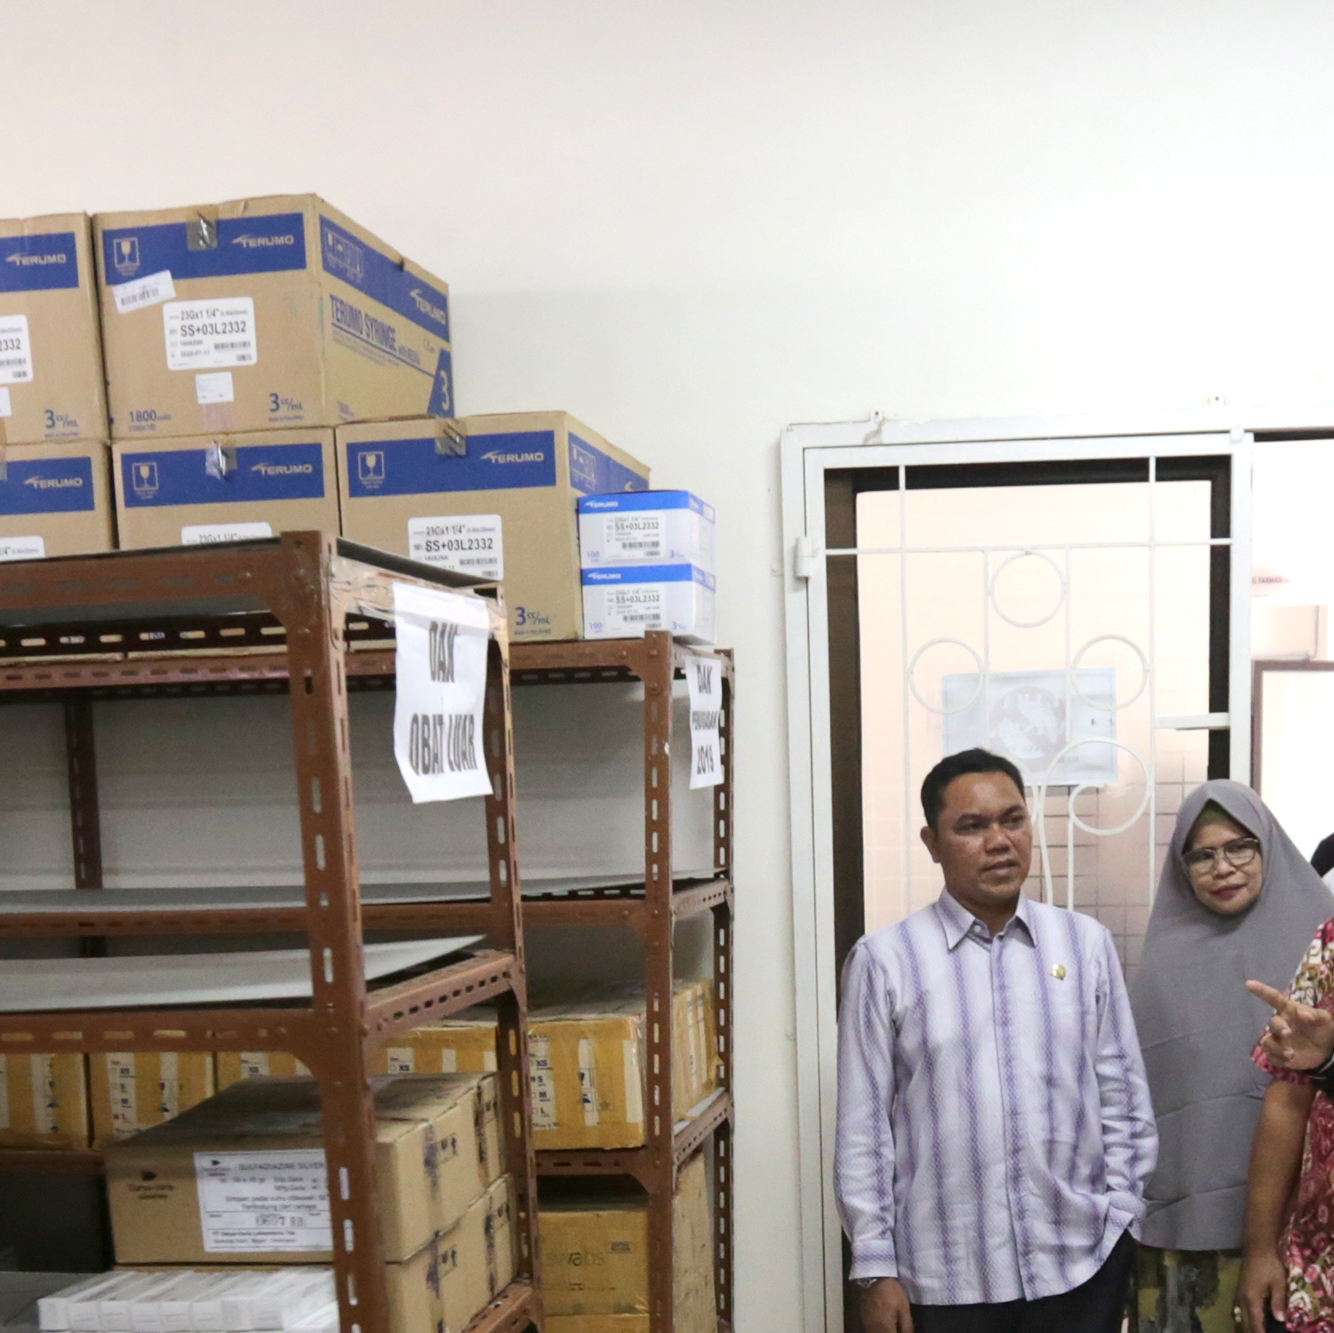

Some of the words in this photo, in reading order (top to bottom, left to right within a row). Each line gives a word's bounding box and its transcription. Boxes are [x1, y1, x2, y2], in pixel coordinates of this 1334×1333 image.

[242, 234, 295, 249] TERUMO
[14, 253, 67, 267] TERUMO
[415, 297, 447, 326] TERUMO
[180, 321, 247, 337] SS+03L2332
[330, 294, 363, 336] TERUMO
[365, 316, 397, 351] SYRINGE
[440, 369, 450, 411] 3
[268, 392, 280, 413] 3
[44, 409, 56, 429] 3
[129, 409, 157, 422] 1800
[490, 451, 545, 464] TERUMO
[260, 463, 314, 476] TERUMO
[32, 476, 84, 489] TERUMO
[615, 521, 660, 532] SS+03L2332
[425, 537, 494, 552] SS+03L2332
[616, 594, 660, 604] SS+03L2332
[514, 606, 527, 626] 3
[428, 620, 460, 684] DAK
[696, 664, 713, 695] DAK
[408, 712, 446, 777] OBAT
[446, 712, 479, 773] LUAR
